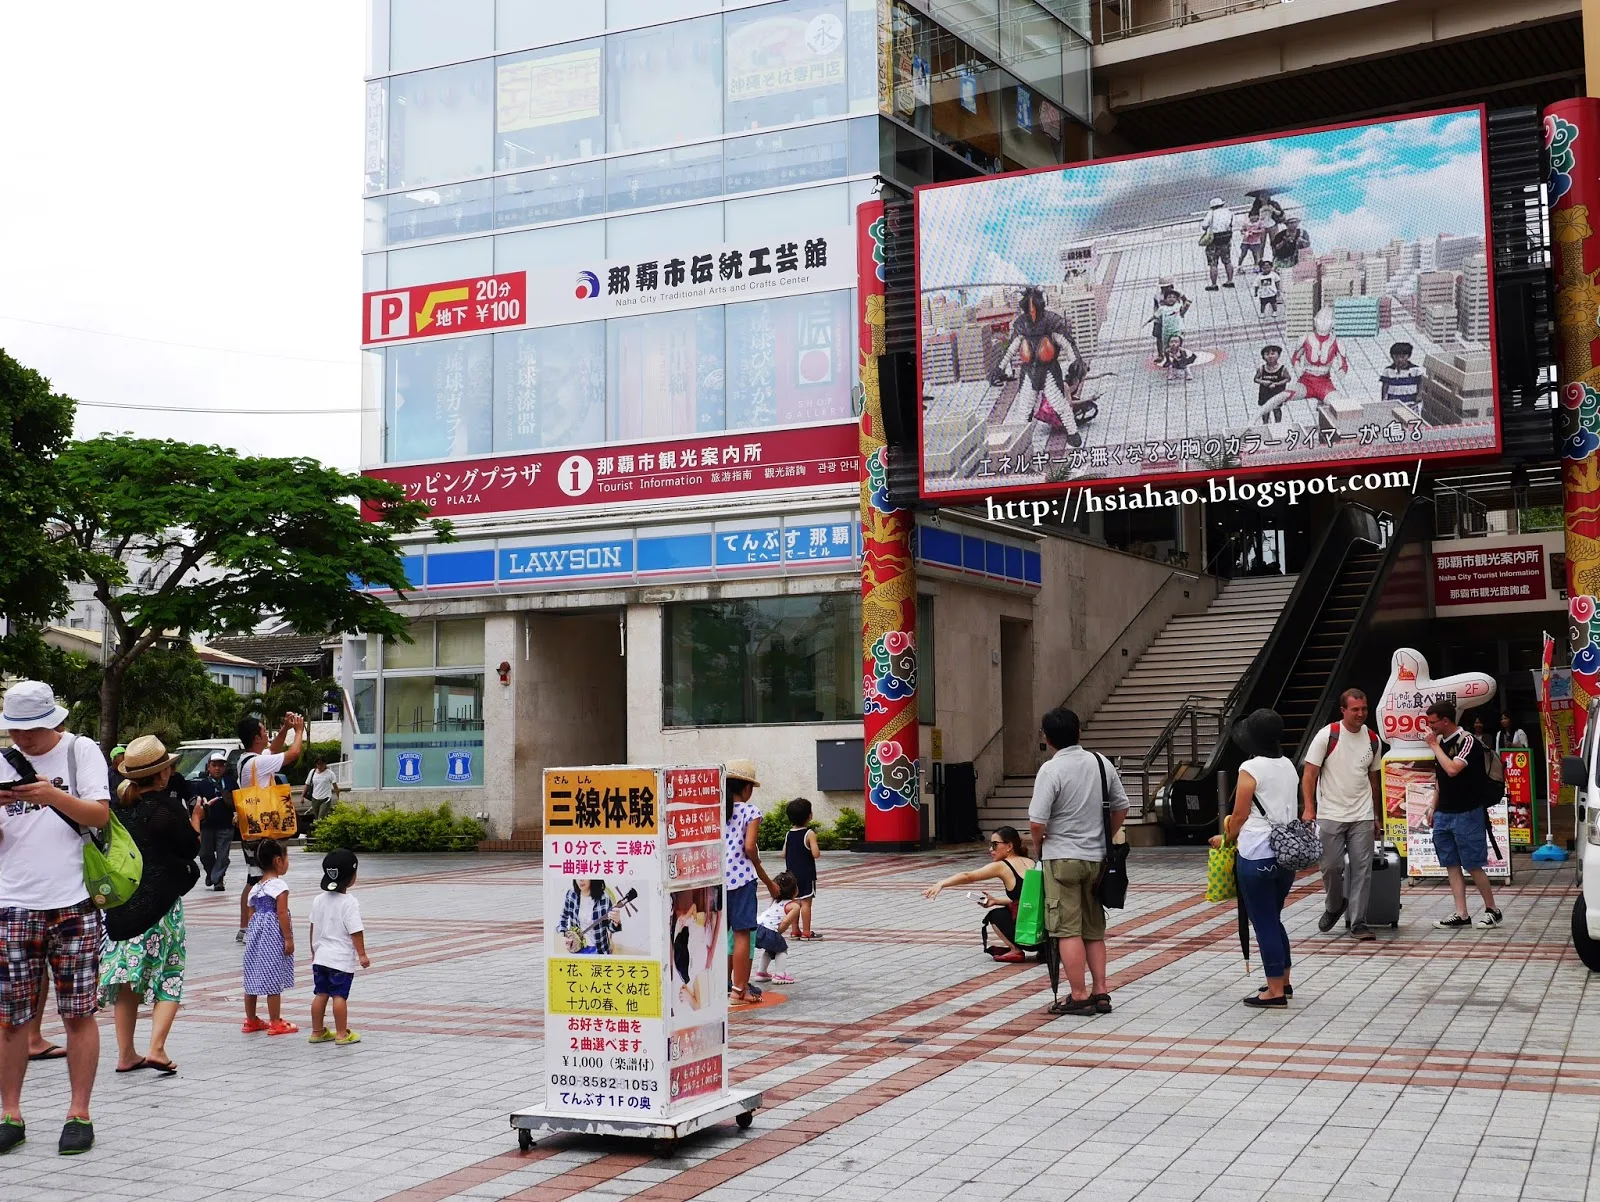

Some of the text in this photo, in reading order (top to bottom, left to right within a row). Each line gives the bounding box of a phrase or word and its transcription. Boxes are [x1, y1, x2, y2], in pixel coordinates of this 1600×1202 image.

[608, 238, 828, 295] 那覇市伝統工芸館
[476, 279, 511, 301] 20分
[615, 276, 810, 307] Naha City Traditional Arts and Crafts Center
[381, 297, 403, 336] P
[436, 306, 468, 327] 地下
[476, 299, 520, 323] ¥100
[798, 397, 833, 409] SHOP
[784, 405, 845, 420] GALLERY
[978, 419, 1423, 477] エネルギーが無くなると胸のカラータイマーが鳴る
[597, 442, 763, 476] 那覇市観光案内所
[817, 459, 859, 474] 관광 안내
[598, 474, 703, 493] Tourist Information
[711, 471, 753, 484] 旅游指南
[446, 493, 481, 505] PLAZA
[723, 526, 850, 550] てんぶす 那覇
[510, 546, 622, 574] LAWSON
[1437, 550, 1539, 569] 那覇市観光案内所
[1438, 568, 1540, 582] Naha City Tourist Information
[1465, 683, 1480, 695] 2F
[553, 775, 592, 785] さん しん
[549, 786, 655, 829] 三線体験
[549, 859, 634, 876] 一曲弾けます。
[566, 980, 651, 996] てぃんさぐぬ花
[566, 996, 639, 1012] 十九の春、他
[568, 1017, 642, 1034] お好きな曲を
[570, 1037, 648, 1054] 2曲選べます。
[551, 1074, 658, 1092] 080-8582-1053
